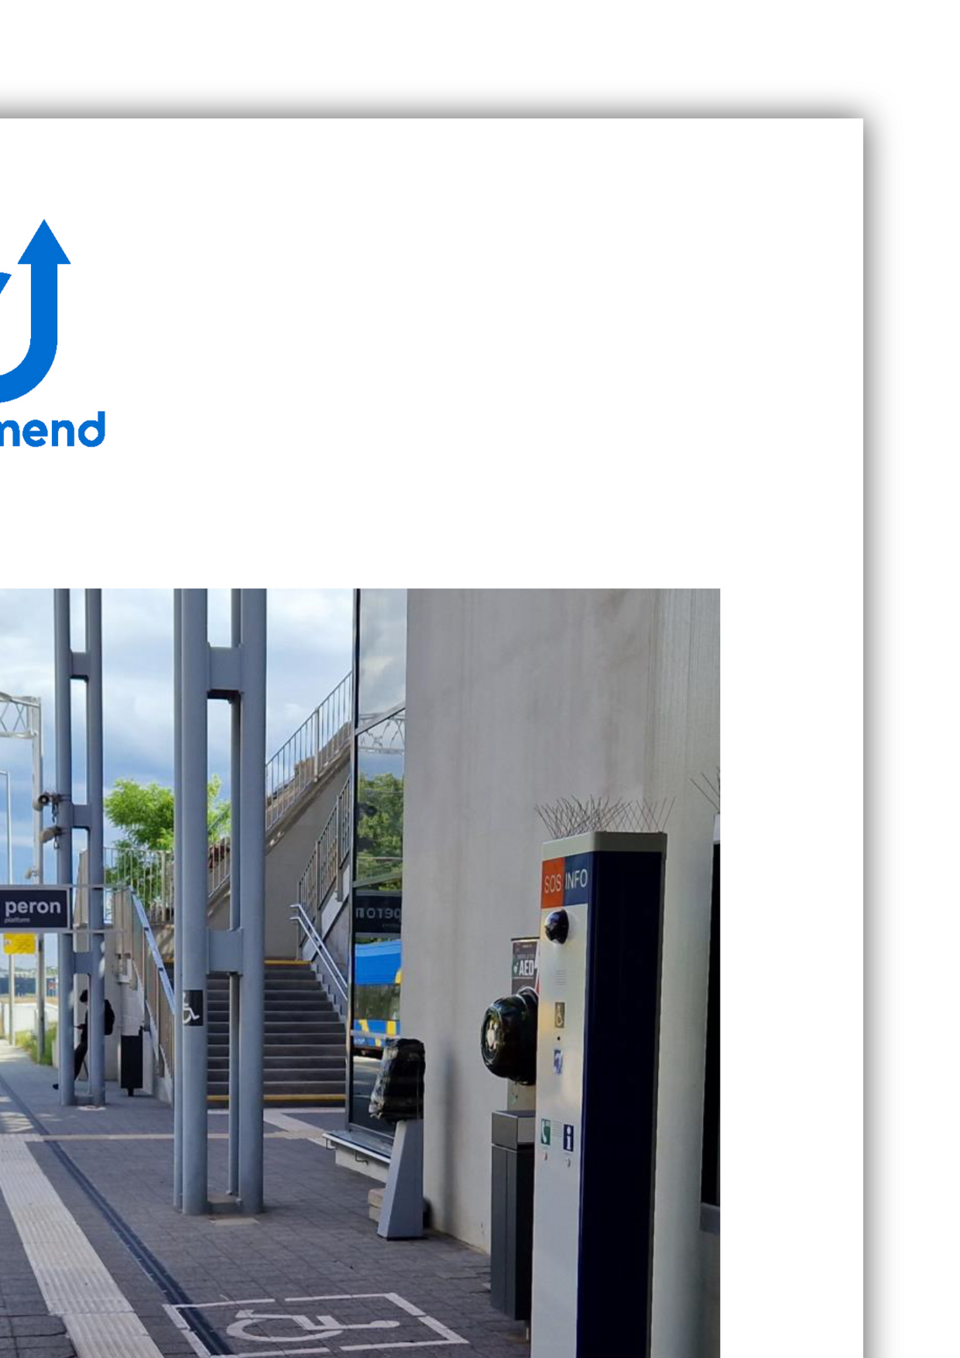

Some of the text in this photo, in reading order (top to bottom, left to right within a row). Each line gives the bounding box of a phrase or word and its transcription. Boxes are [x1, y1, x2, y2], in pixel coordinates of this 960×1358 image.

[544, 869, 588, 894] SOS INFO
[4, 901, 61, 917] peron
[519, 960, 535, 976] AED
